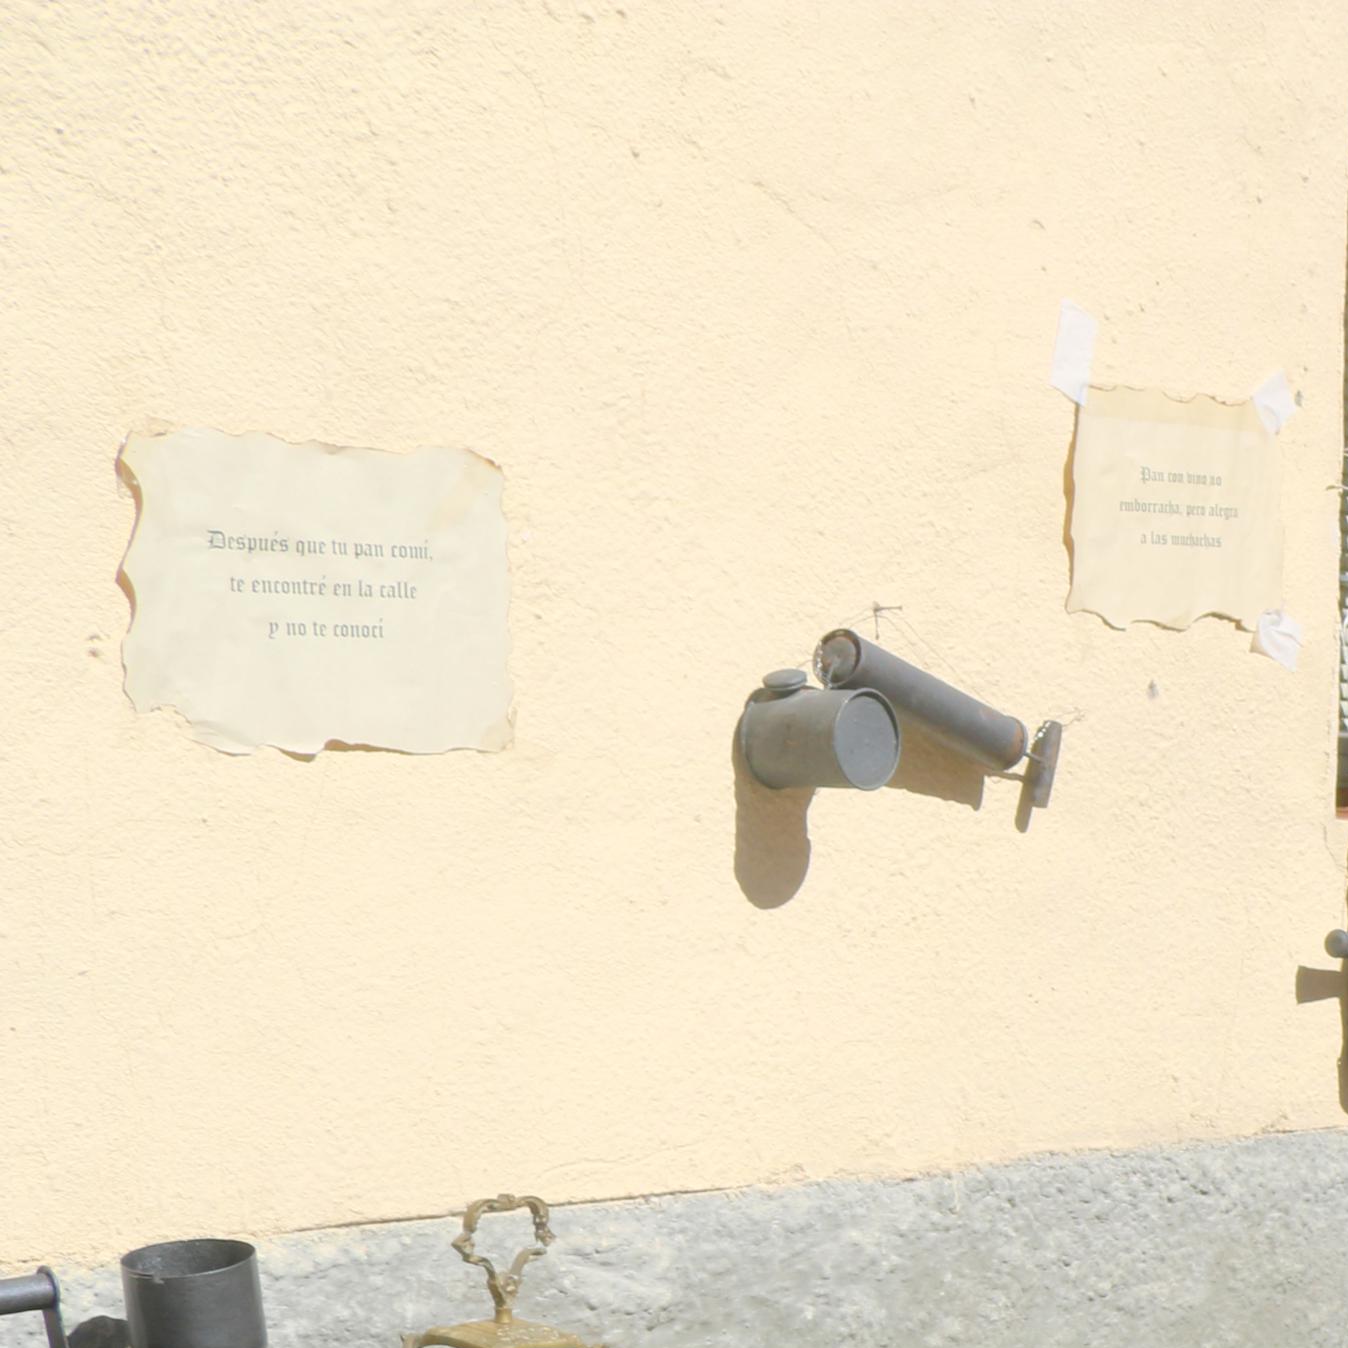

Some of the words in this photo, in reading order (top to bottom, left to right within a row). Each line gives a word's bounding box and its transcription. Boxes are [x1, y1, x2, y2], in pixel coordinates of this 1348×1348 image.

[1140, 465, 1164, 484] Pan
[1167, 471, 1184, 483] con
[1209, 475, 1222, 486] no
[1186, 503, 1205, 517] pero
[1208, 503, 1238, 520] alegra
[207, 530, 289, 554] Después
[295, 539, 326, 557] que
[331, 539, 348, 556] tu
[354, 541, 384, 559] pan
[1140, 533, 1147, 545] a
[1150, 530, 1168, 545] las
[1171, 532, 1222, 548] muchachas
[229, 576, 245, 593] te
[251, 575, 326, 596] encontré
[333, 582, 352, 597] en
[358, 580, 373, 598] la
[379, 581, 418, 600] calle
[268, 621, 279, 639] y
[286, 621, 307, 637] no
[312, 621, 327, 638] te
